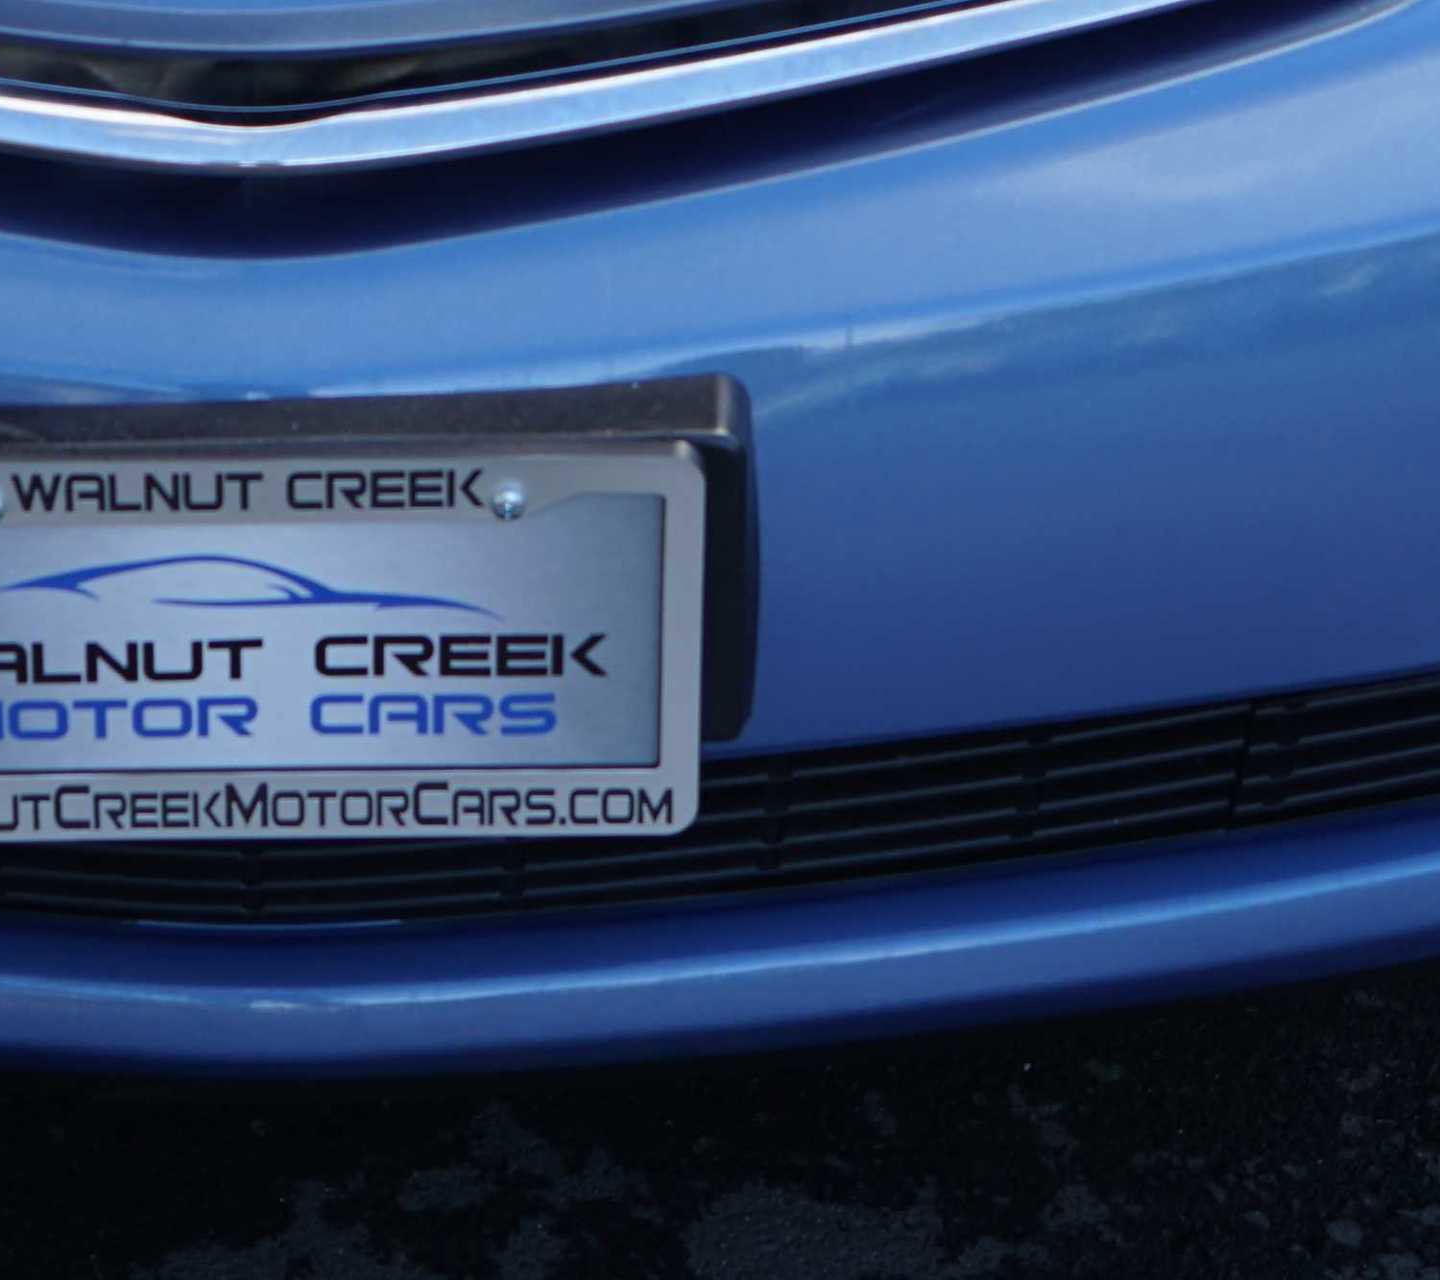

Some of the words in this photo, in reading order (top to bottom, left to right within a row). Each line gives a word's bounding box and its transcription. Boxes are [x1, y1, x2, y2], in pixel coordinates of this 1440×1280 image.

[11, 472, 263, 511] WALNUT
[287, 468, 485, 509] CREEK
[314, 633, 607, 677] CREEK
[311, 693, 558, 736] CARS
